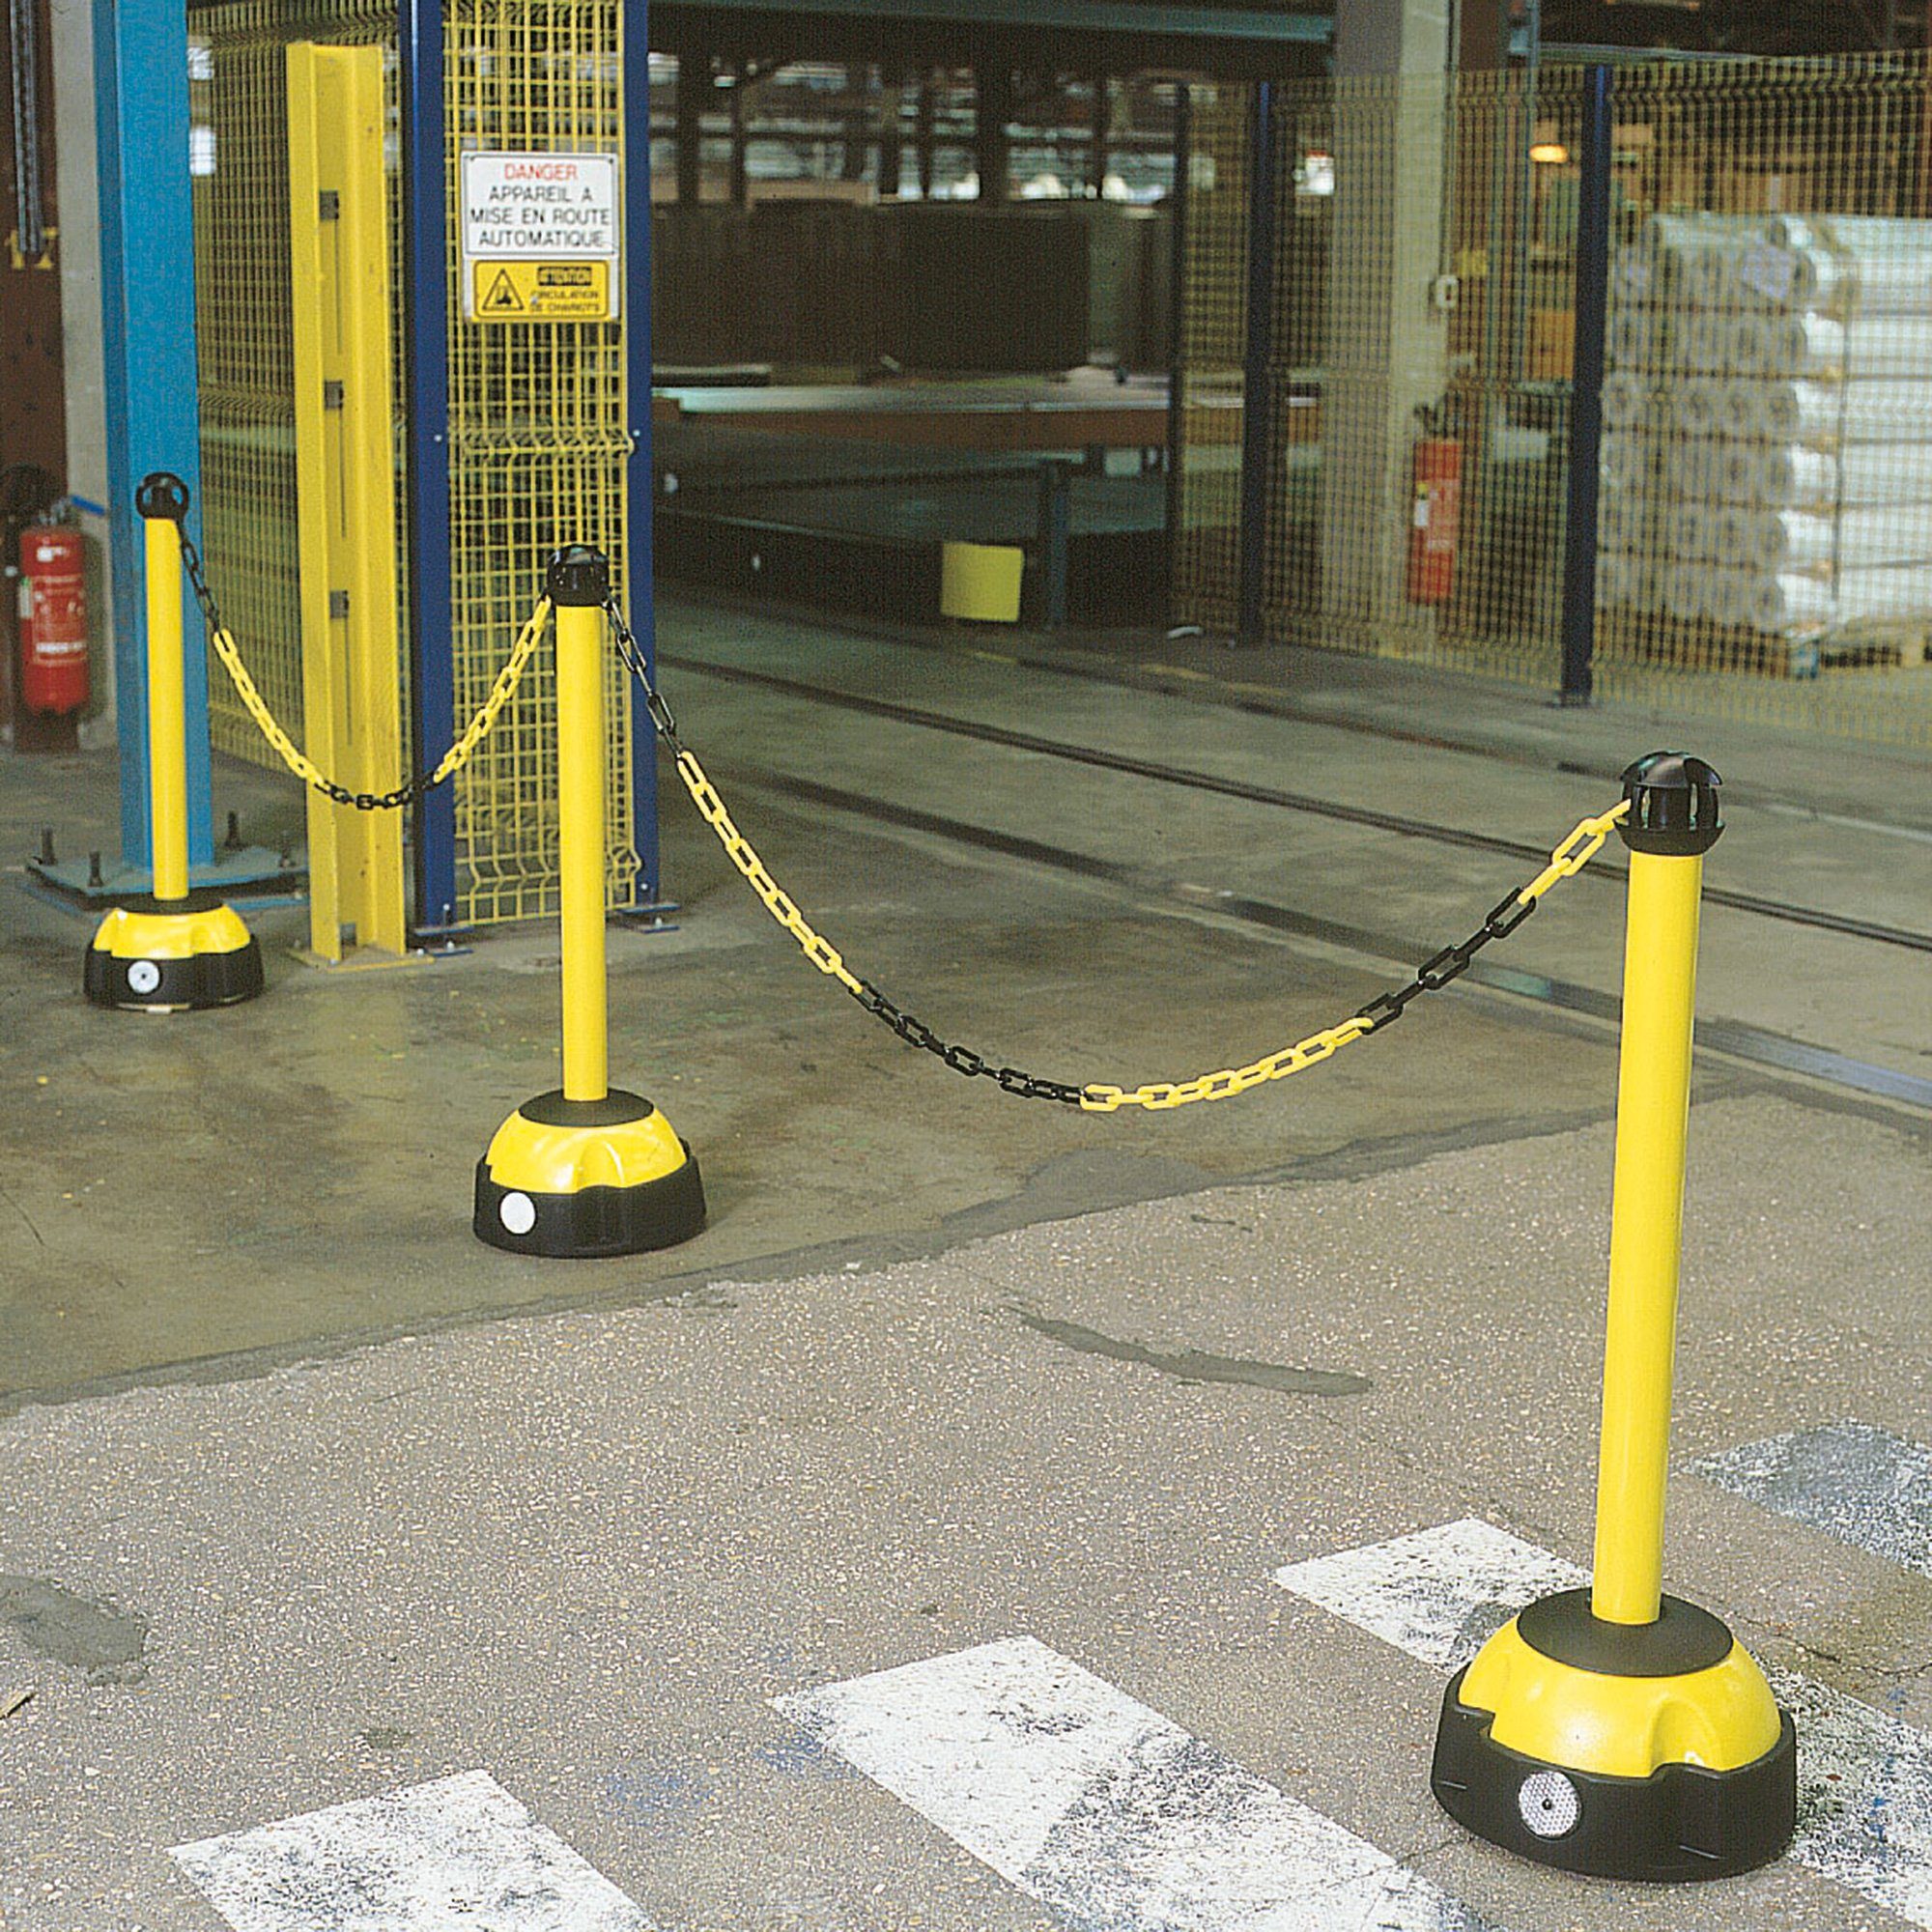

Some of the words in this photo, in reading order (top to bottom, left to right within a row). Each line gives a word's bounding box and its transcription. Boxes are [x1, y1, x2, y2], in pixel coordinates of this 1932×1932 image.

[503, 163, 578, 180] DANGER
[489, 185, 572, 202] APPAREIL
[469, 208, 513, 224] MISE
[522, 209, 545, 224] EN
[553, 209, 611, 225] ROUTE
[479, 230, 604, 247] AUTOMATIQUE
